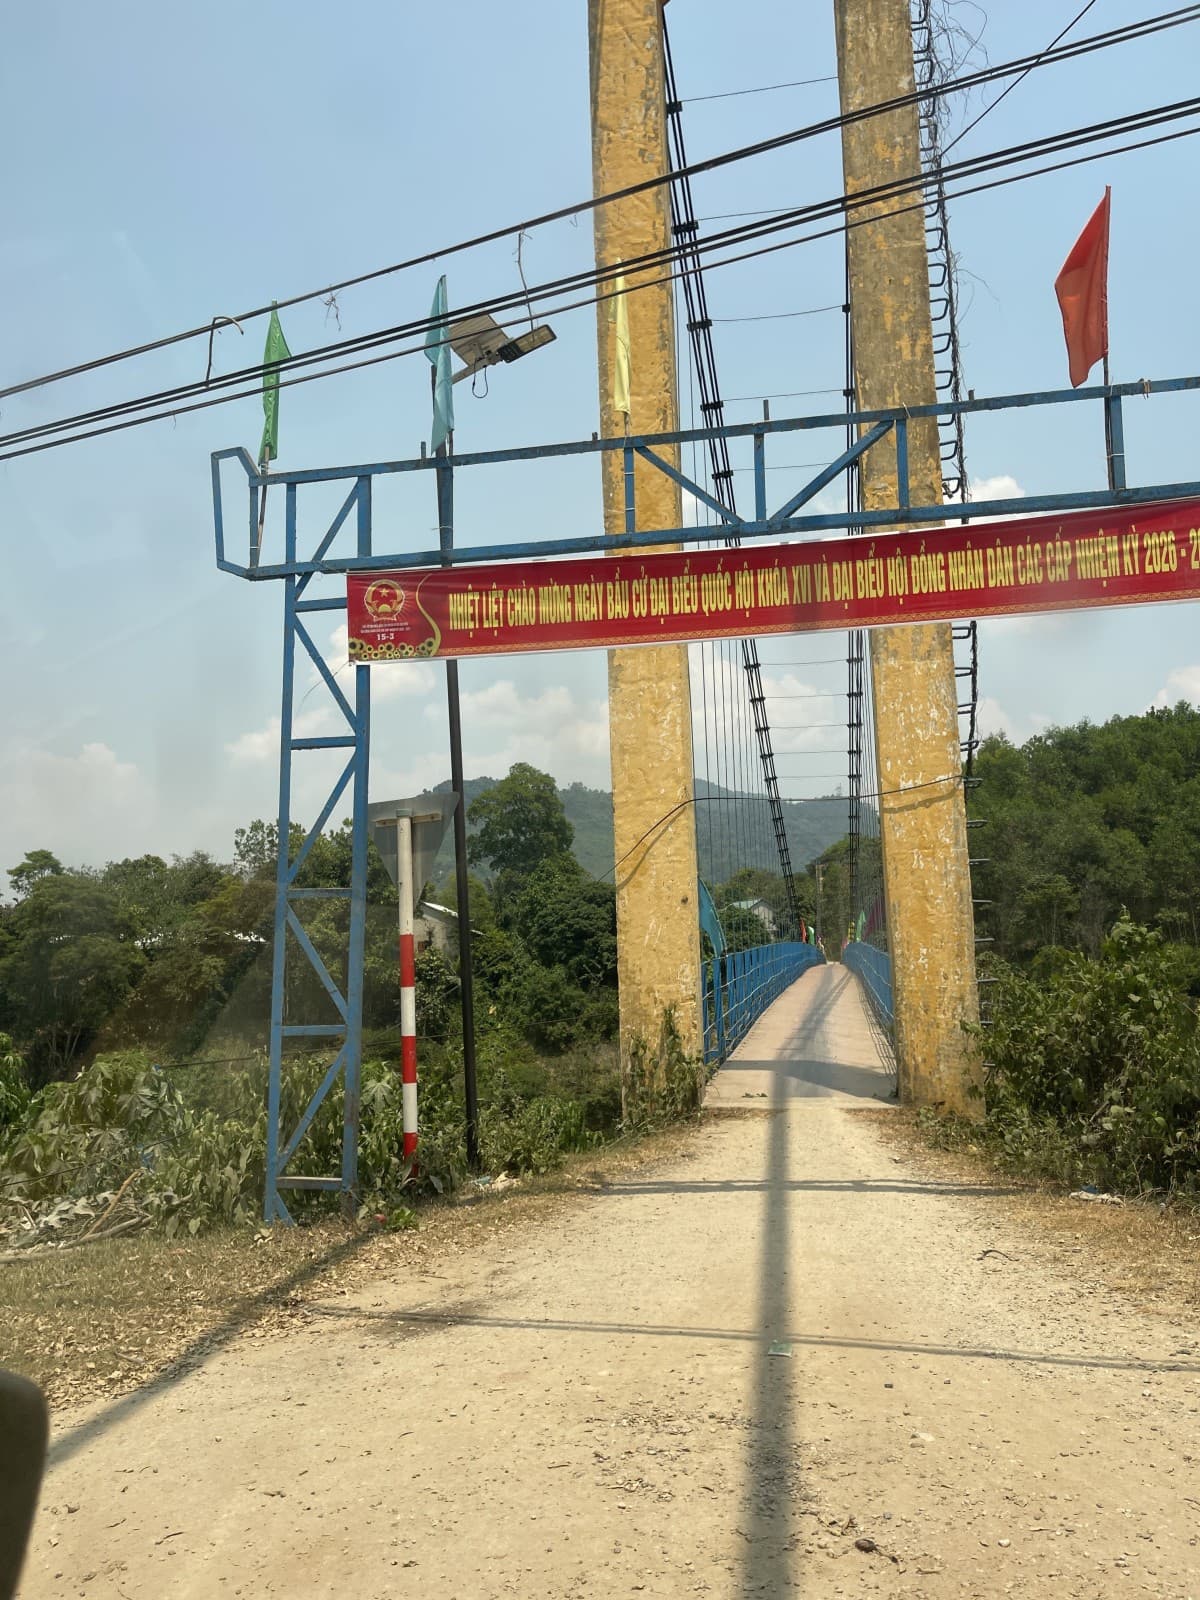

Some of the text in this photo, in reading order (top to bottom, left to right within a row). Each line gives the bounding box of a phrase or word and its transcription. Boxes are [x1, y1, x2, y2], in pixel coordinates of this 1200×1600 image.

[449, 584, 480, 638] NHIỆT
[482, 582, 504, 637] LIỆT
[507, 580, 536, 627] CHÀO
[539, 578, 571, 625] MỪNG
[575, 575, 604, 623] NGÀY
[632, 565, 648, 618] CỬ
[650, 576, 669, 625] ĐẠI
[672, 559, 698, 614] BIỂU
[701, 557, 731, 616] QUỐC
[735, 561, 755, 618] HỘI
[757, 558, 789, 607] KHÓA
[791, 563, 812, 604] XVI
[814, 554, 831, 602] VÀ
[832, 560, 854, 610] ĐẠI
[856, 541, 884, 600] BIỂU
[887, 547, 909, 605] HỘI
[948, 540, 984, 591] NHÂN
[987, 537, 1014, 588] DÂN
[1017, 535, 1043, 585] CÁC
[1046, 525, 1071, 583] CẤP
[1075, 528, 1120, 588] NHIỆM
[1122, 524, 1139, 576] KỲ
[1143, 530, 1177, 573] 2026
[377, 632, 394, 640] 15-3
